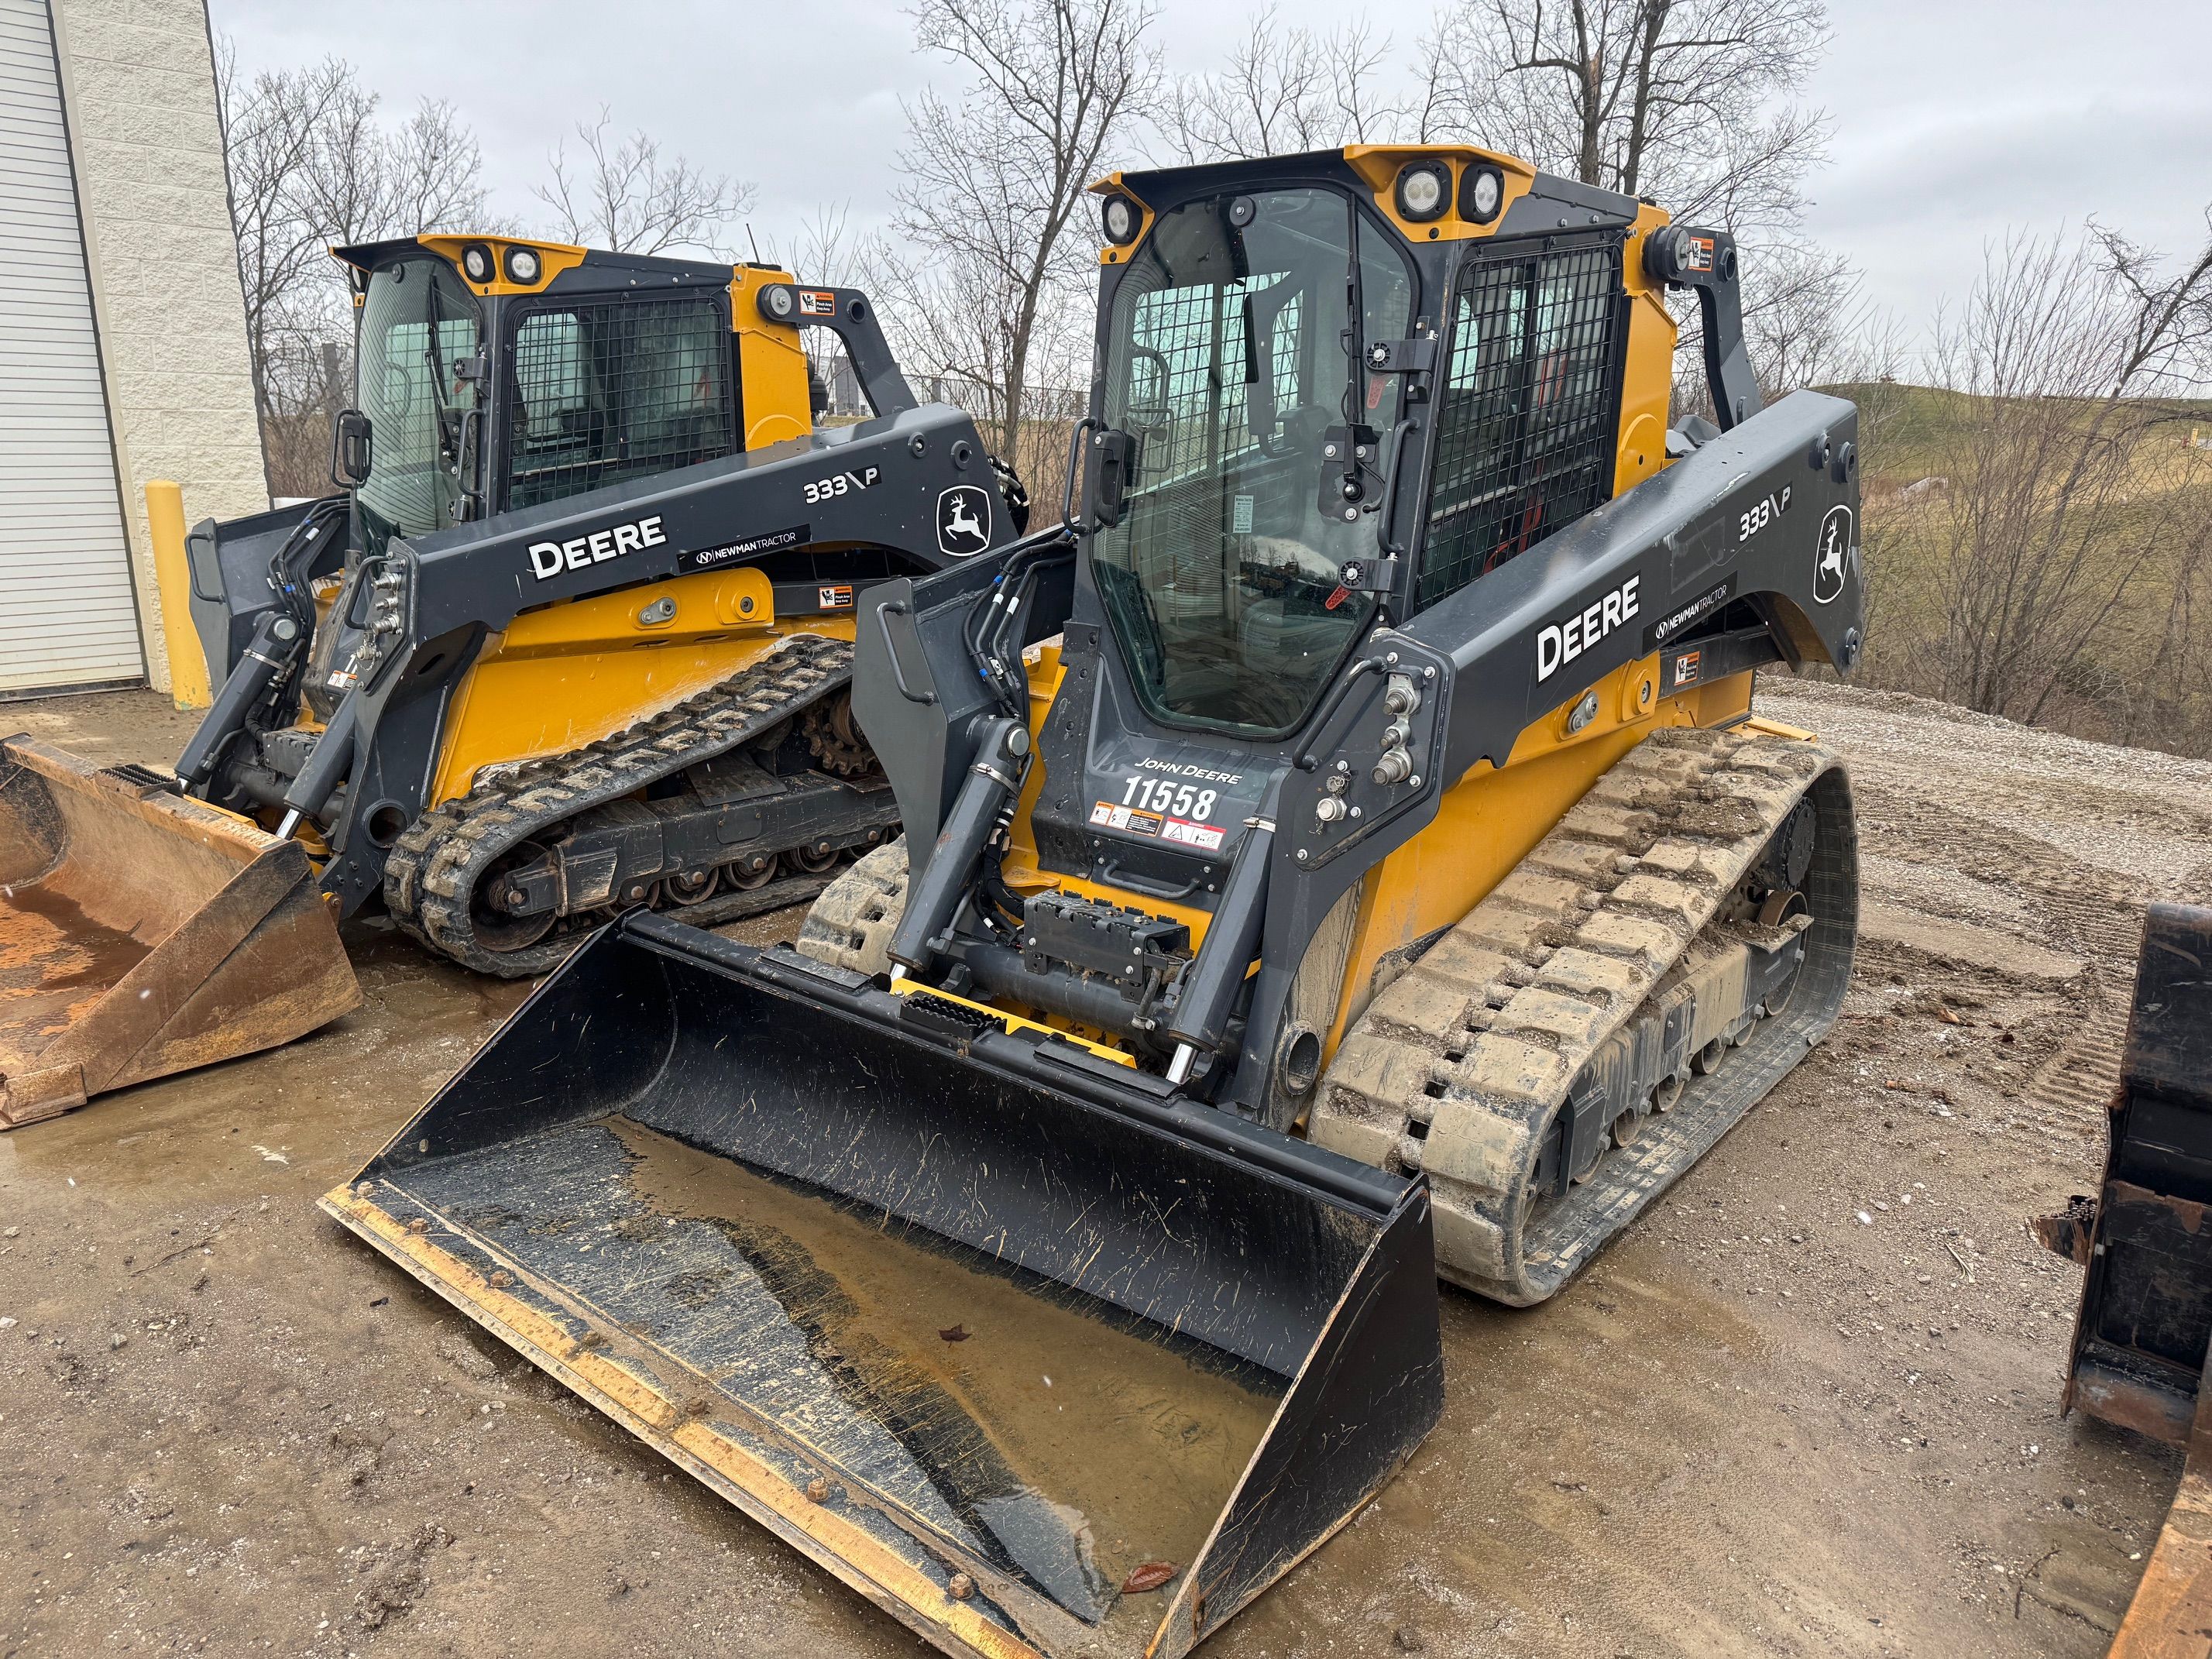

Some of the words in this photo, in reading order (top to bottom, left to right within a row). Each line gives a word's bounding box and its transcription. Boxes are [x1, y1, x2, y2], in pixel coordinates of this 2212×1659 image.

[528, 516, 666, 580] DEERE
[1537, 575, 1640, 683] DEERE
[1121, 775, 1218, 821] 11558
[1134, 757, 1183, 775] JOHN
[1181, 764, 1244, 785] DEERE
